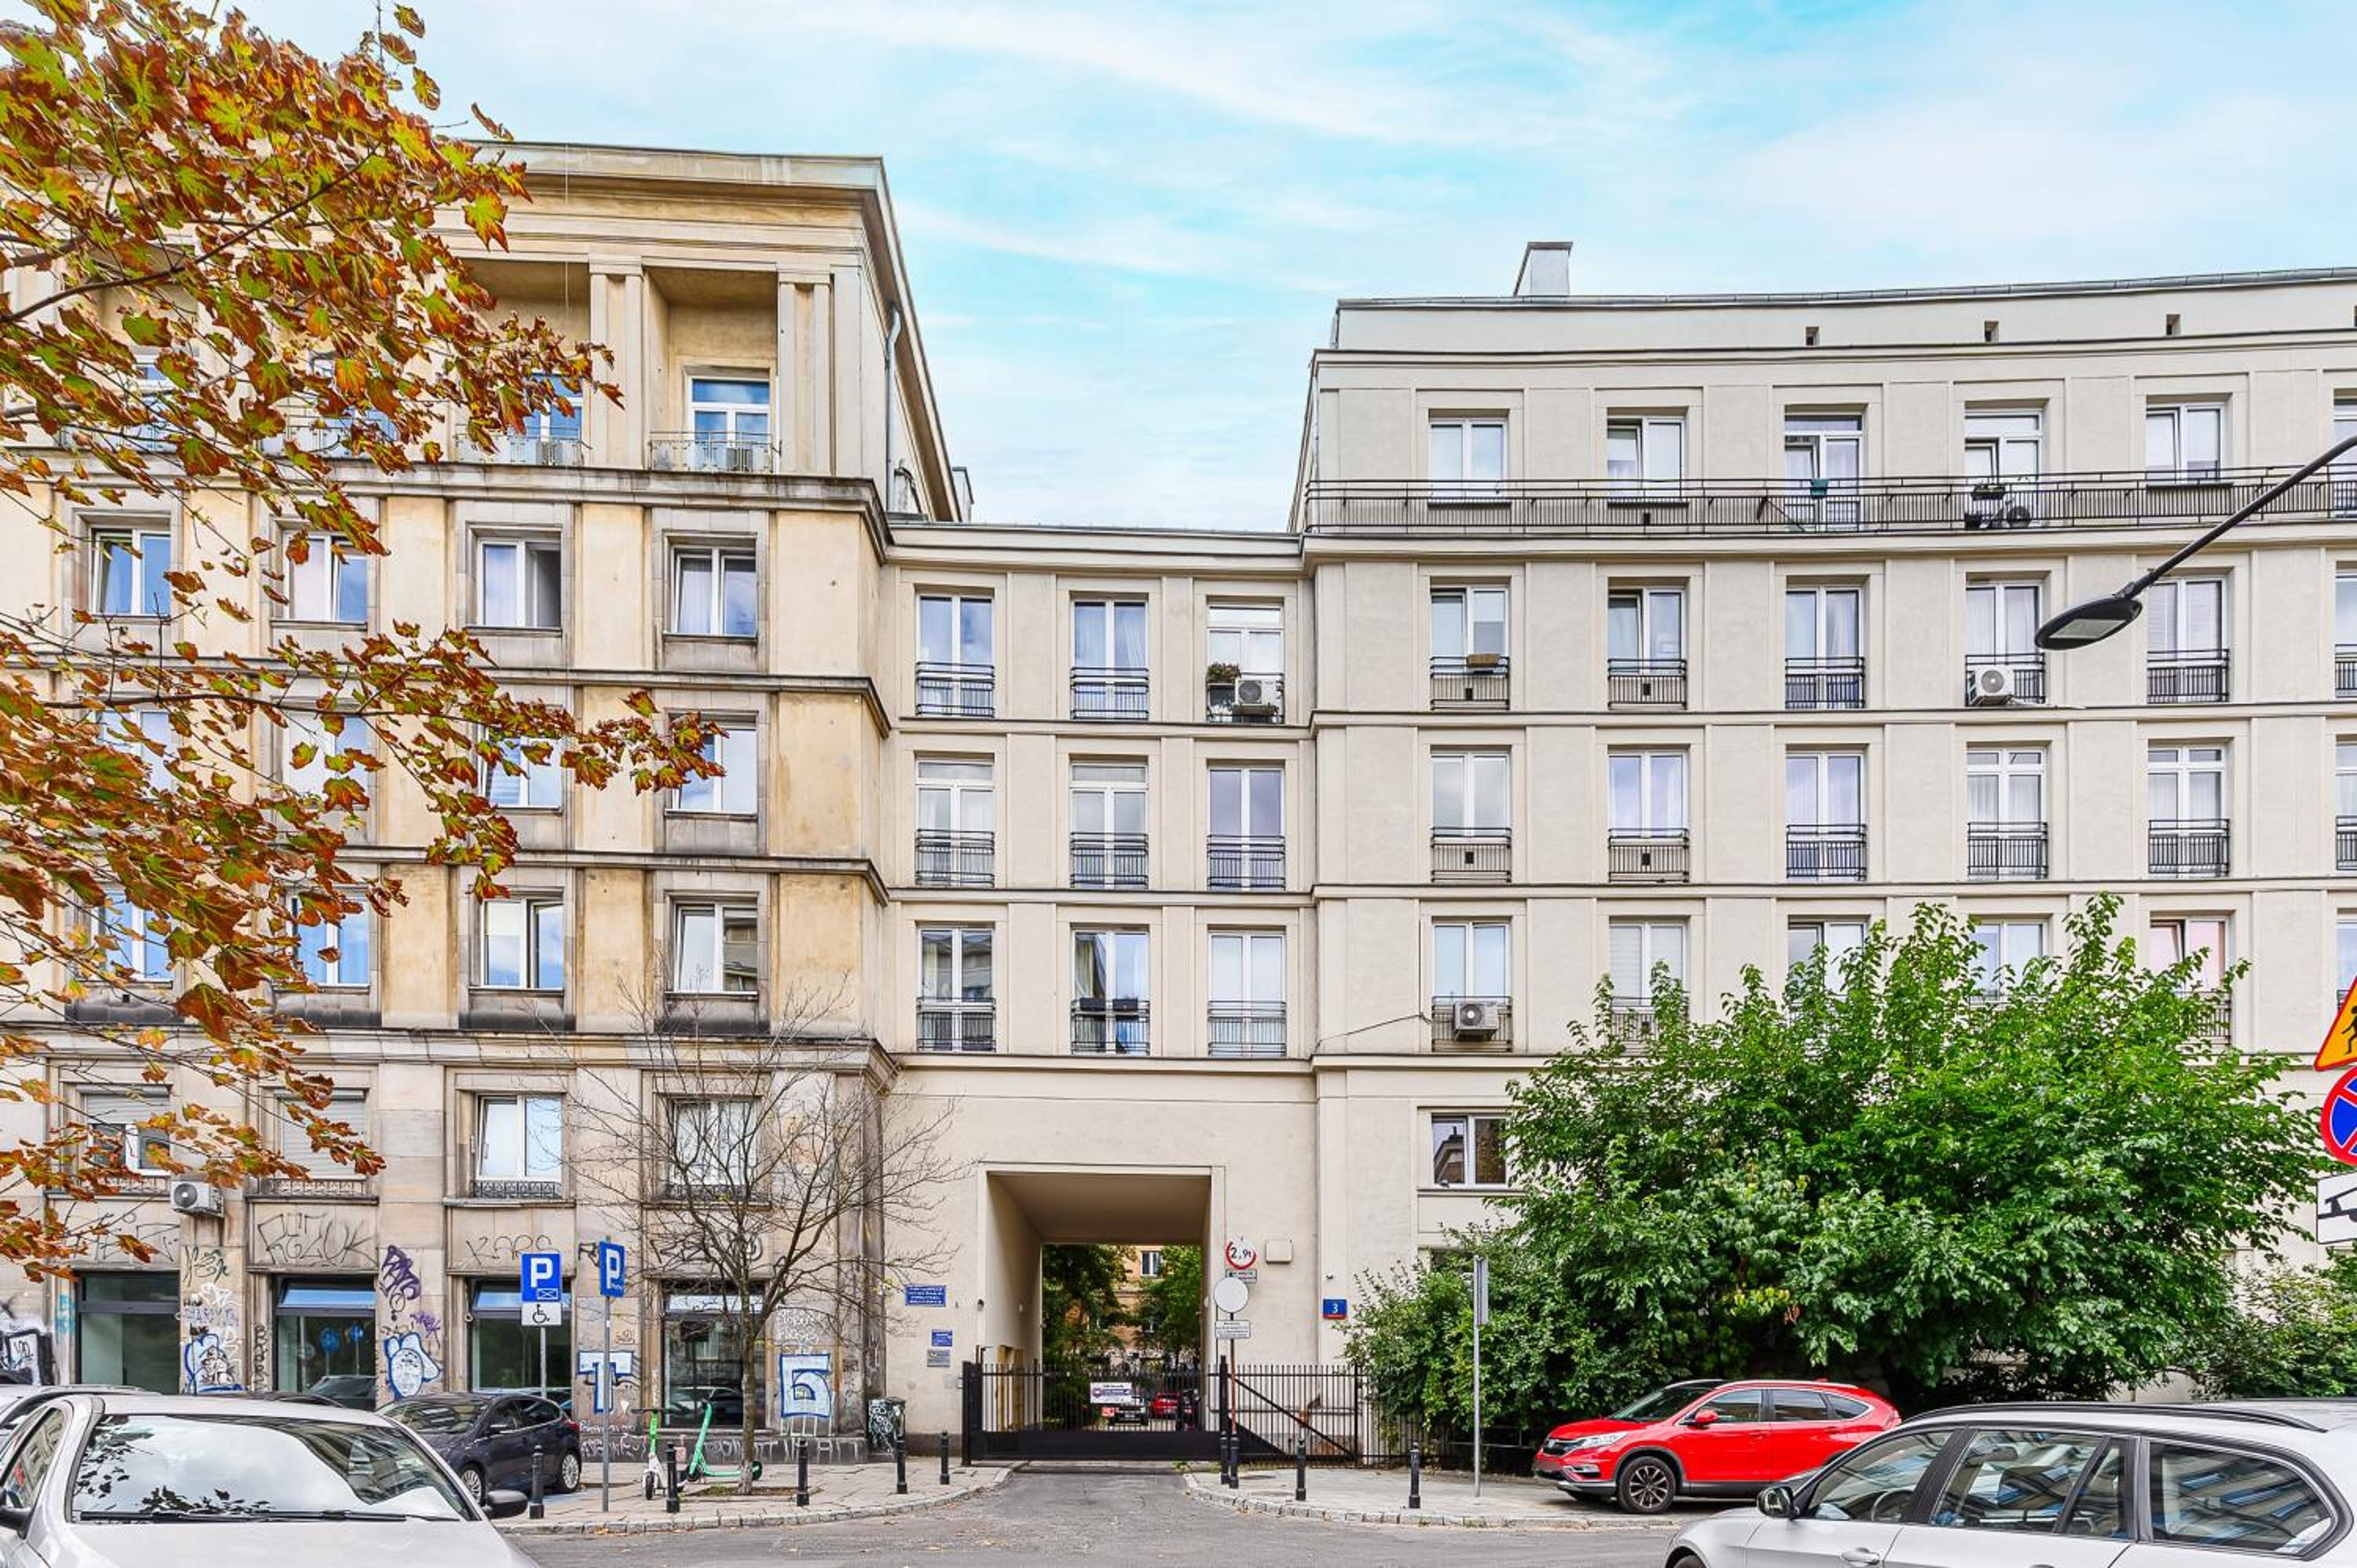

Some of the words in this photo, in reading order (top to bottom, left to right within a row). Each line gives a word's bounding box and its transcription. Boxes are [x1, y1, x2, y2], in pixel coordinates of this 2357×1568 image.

[530, 1258, 553, 1288] P
[606, 1248, 621, 1289] P
[1332, 1303, 1339, 1313] 3
